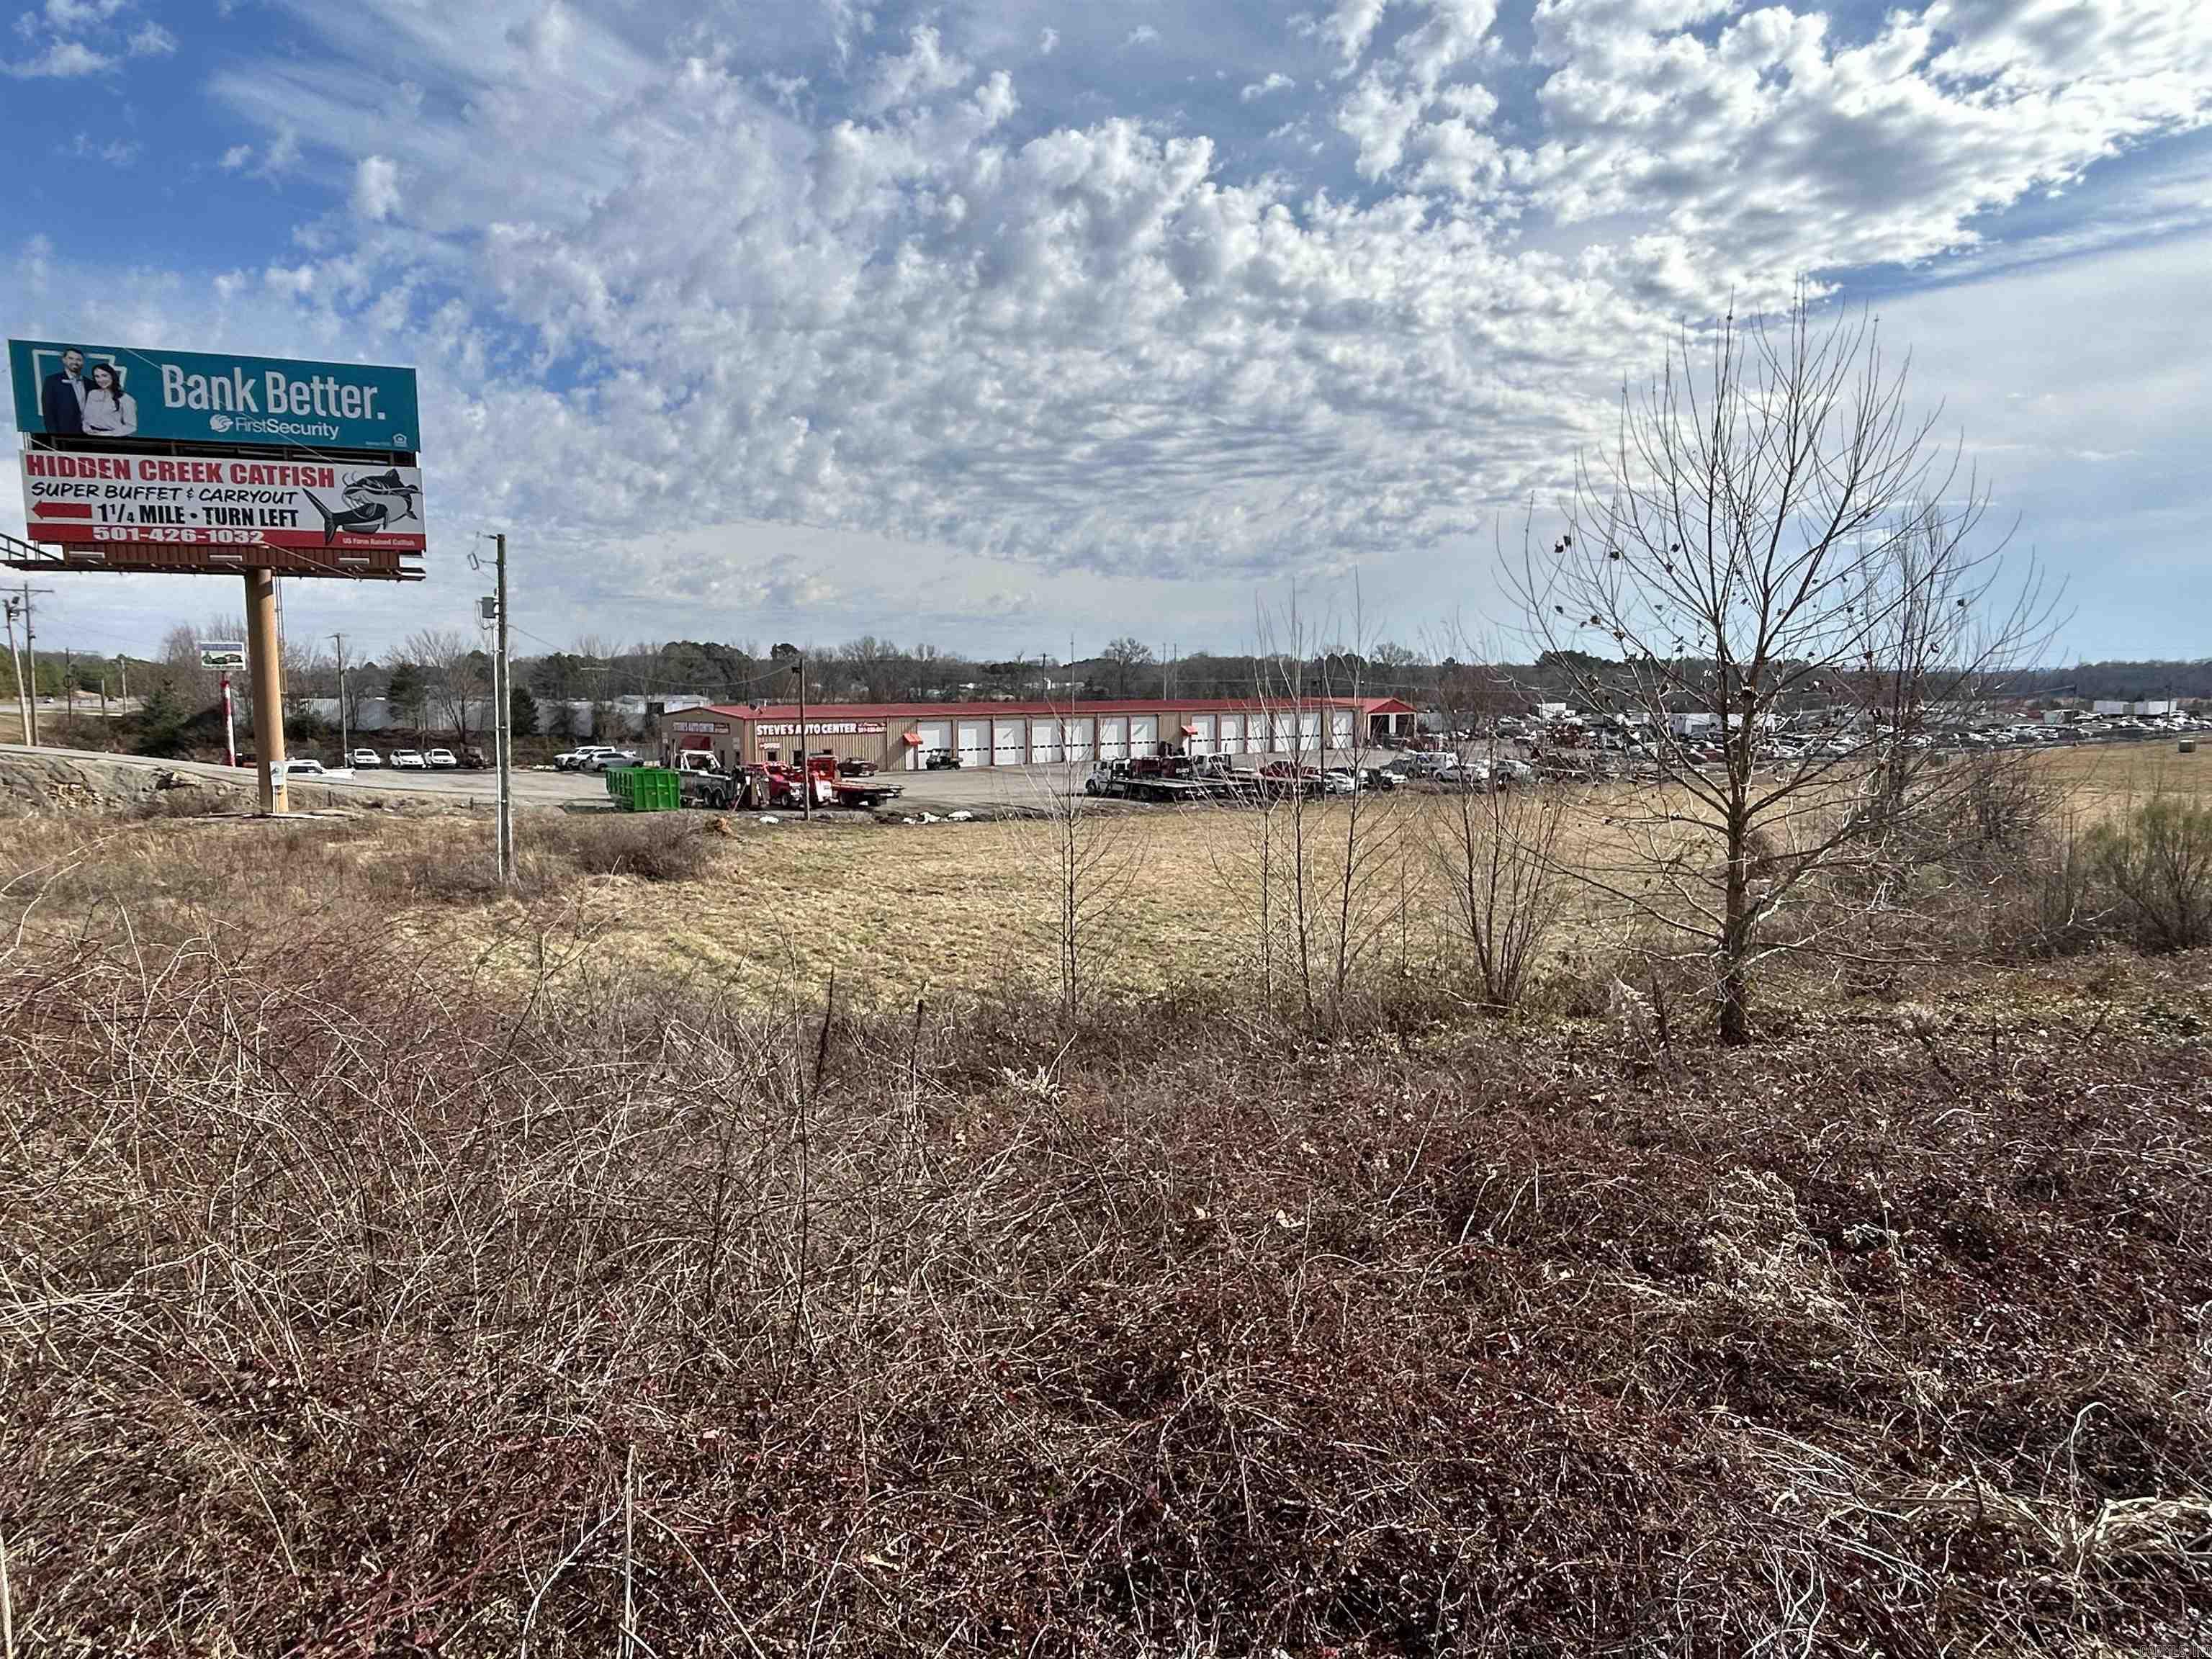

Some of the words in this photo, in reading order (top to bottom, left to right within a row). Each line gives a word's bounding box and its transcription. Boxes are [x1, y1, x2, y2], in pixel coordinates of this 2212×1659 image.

[161, 364, 258, 413] Bank
[265, 370, 386, 421] Better.
[235, 417, 339, 440] FirstSecurity
[26, 454, 131, 480] HIDDEN
[138, 459, 224, 483] CREEK
[230, 463, 335, 487] CATFISH
[31, 482, 99, 498] SUPER
[104, 485, 182, 500] BUFFET
[186, 486, 194, 501] &
[199, 487, 298, 504] CARRYOUT
[138, 504, 185, 524] MILE
[202, 506, 254, 526] TURN
[259, 508, 299, 527] LEFT
[92, 526, 266, 544] 501-426-1032
[757, 724, 794, 735] STEVE'S
[821, 722, 857, 733] CENTER
